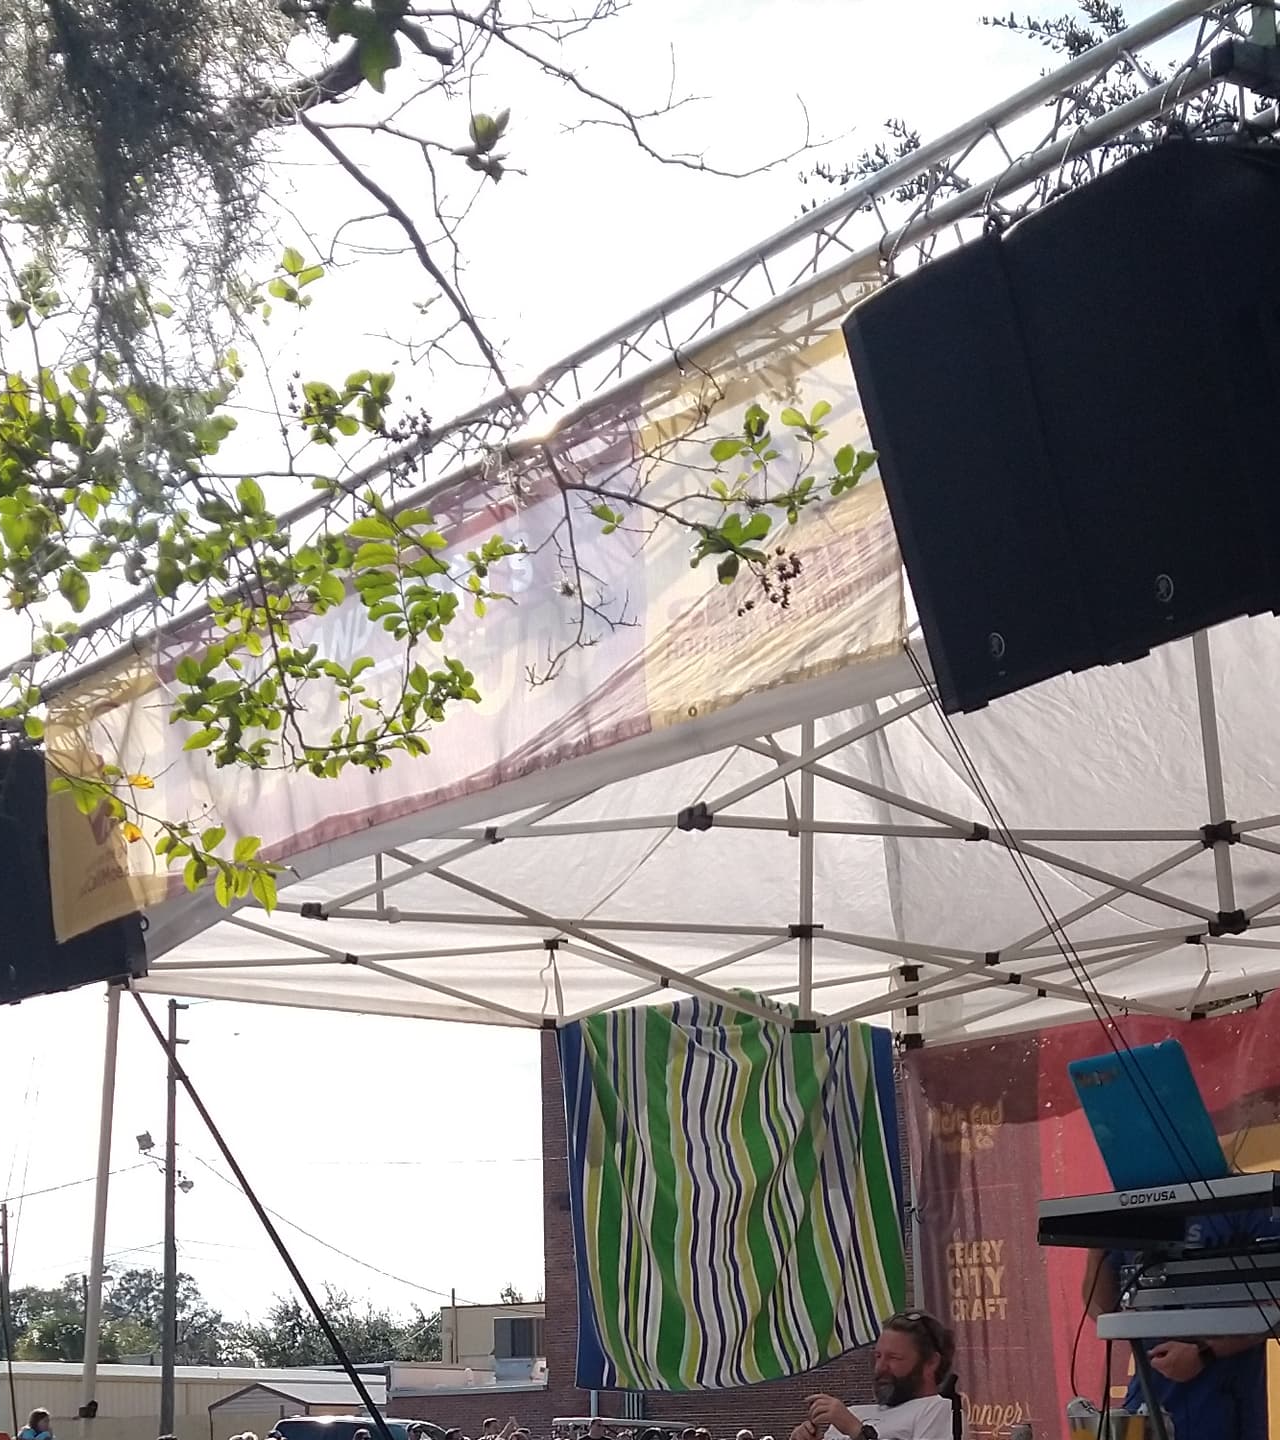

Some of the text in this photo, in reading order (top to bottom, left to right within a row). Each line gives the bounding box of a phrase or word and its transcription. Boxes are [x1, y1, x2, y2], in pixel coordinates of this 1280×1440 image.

[946, 1240, 1005, 1264] CELERY
[948, 1265, 1005, 1297] CITY
[950, 1298, 1008, 1321] CRAFT
